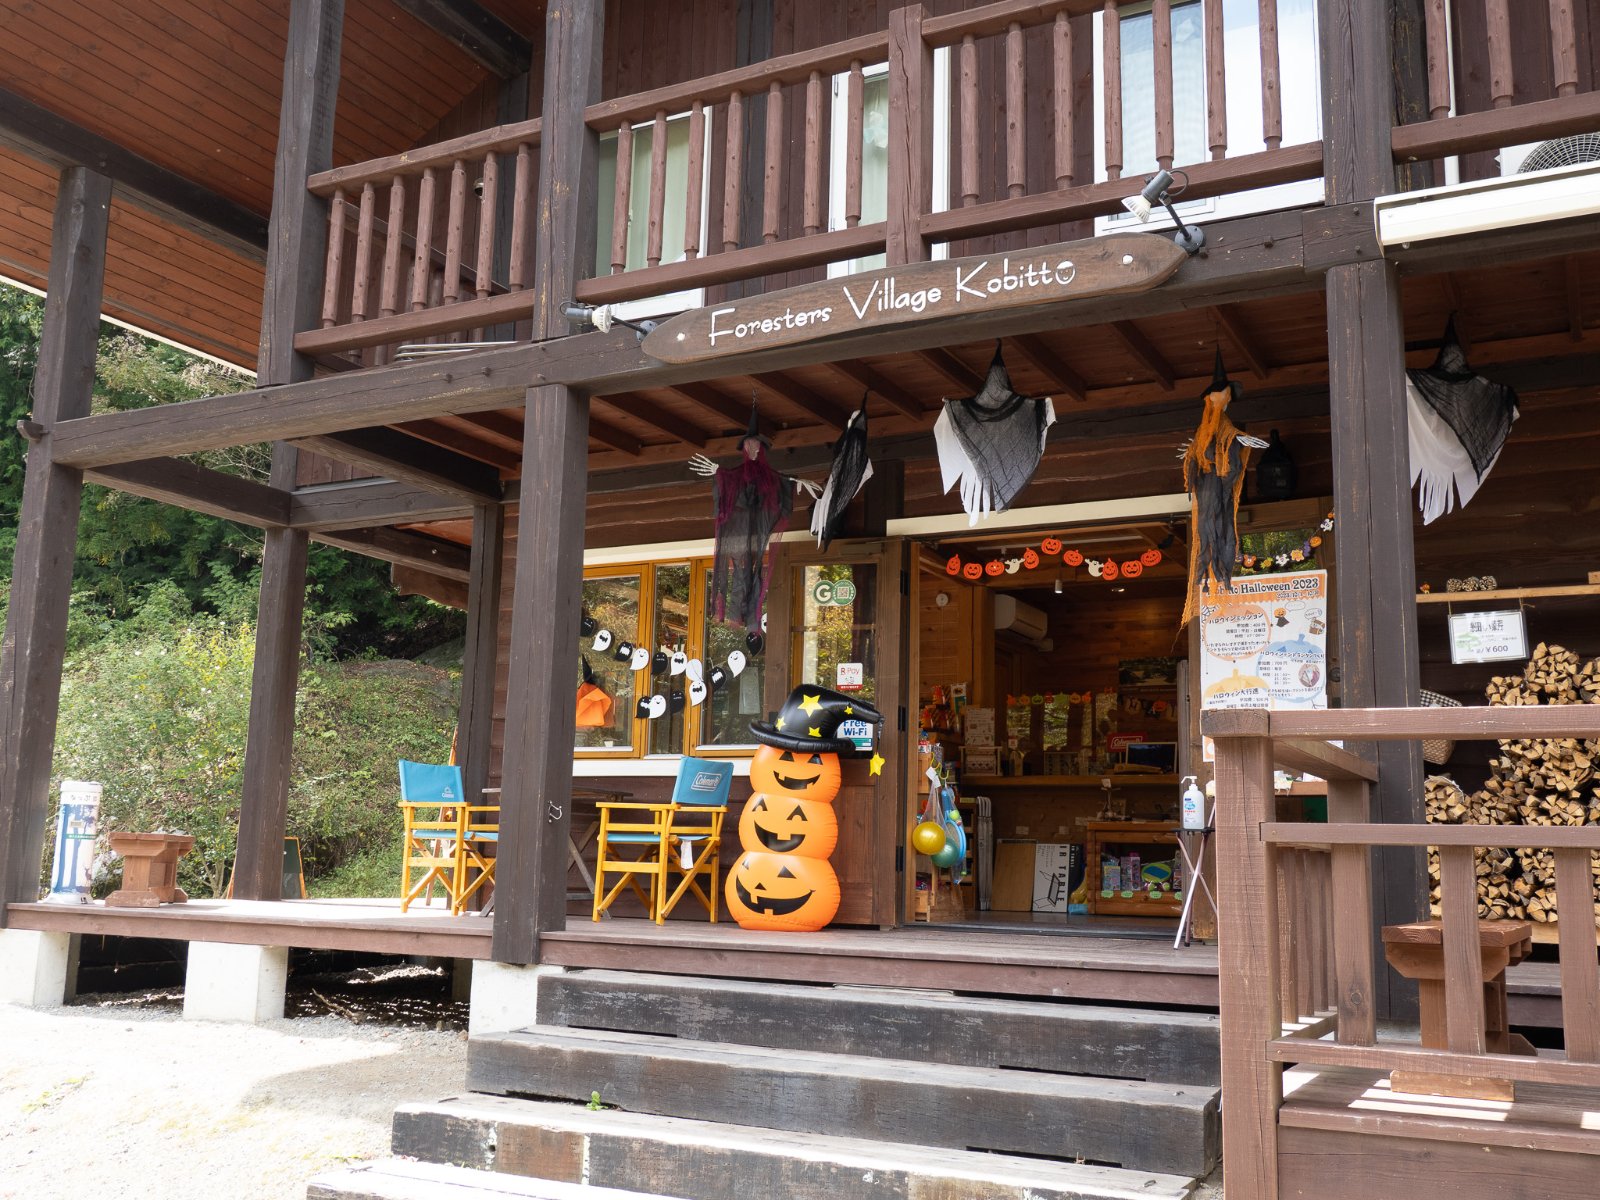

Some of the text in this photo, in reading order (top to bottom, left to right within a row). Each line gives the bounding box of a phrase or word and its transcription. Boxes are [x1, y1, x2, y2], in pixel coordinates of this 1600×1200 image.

[708, 257, 1076, 347] Foresters Village Kobitto
[1240, 581, 1290, 593] Halloween
[1292, 577, 1319, 591] 2023
[816, 584, 832, 602] G
[1208, 612, 1264, 625] ハロウィンミッション
[847, 667, 860, 675] Pay
[1213, 687, 1260, 699] ハロウィン大行進
[844, 719, 867, 727] Free
[844, 727, 867, 736] Wi-Fi
[1057, 865, 1067, 902] TABLE
